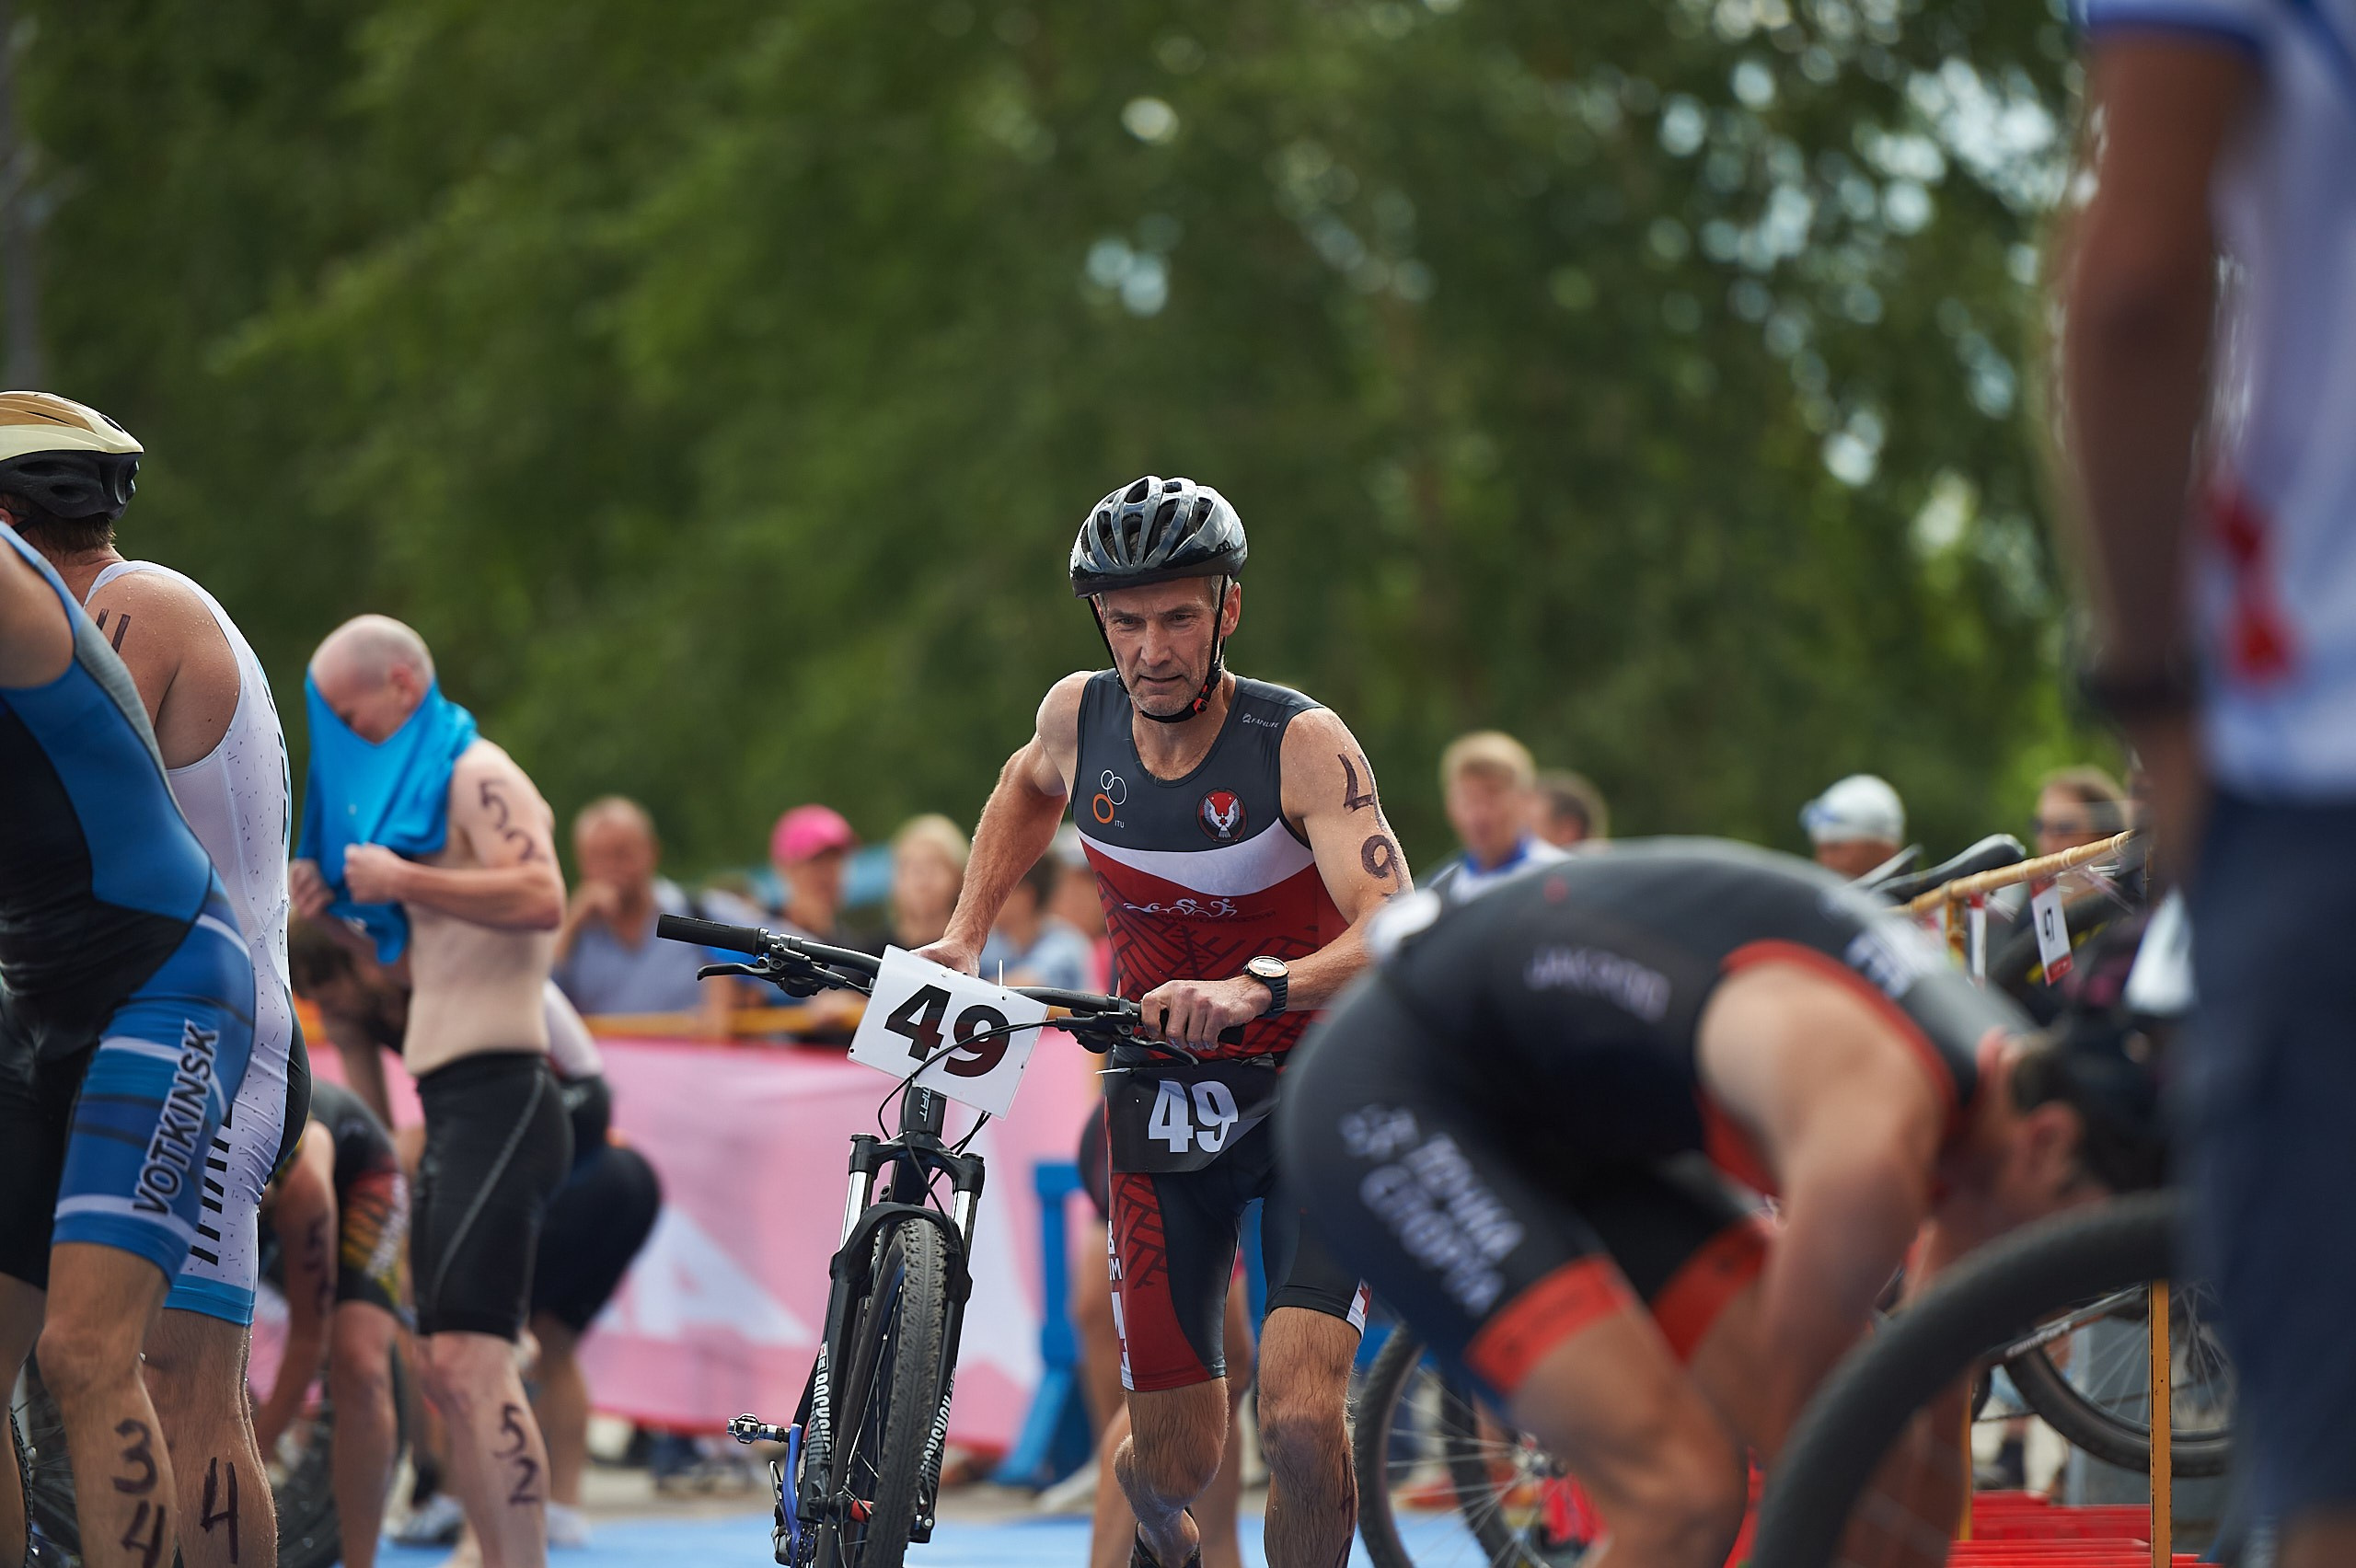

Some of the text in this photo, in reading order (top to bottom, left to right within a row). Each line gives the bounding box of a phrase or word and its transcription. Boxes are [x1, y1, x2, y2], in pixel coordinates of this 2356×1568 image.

[1114, 819, 1126, 829] ITU
[884, 984, 1011, 1078] 49
[133, 1020, 220, 1216] VOTKINSK
[1147, 1080, 1239, 1153] 49
[112, 1419, 166, 1568] 34
[493, 1402, 541, 1505] 52
[200, 1457, 238, 1563] 4
